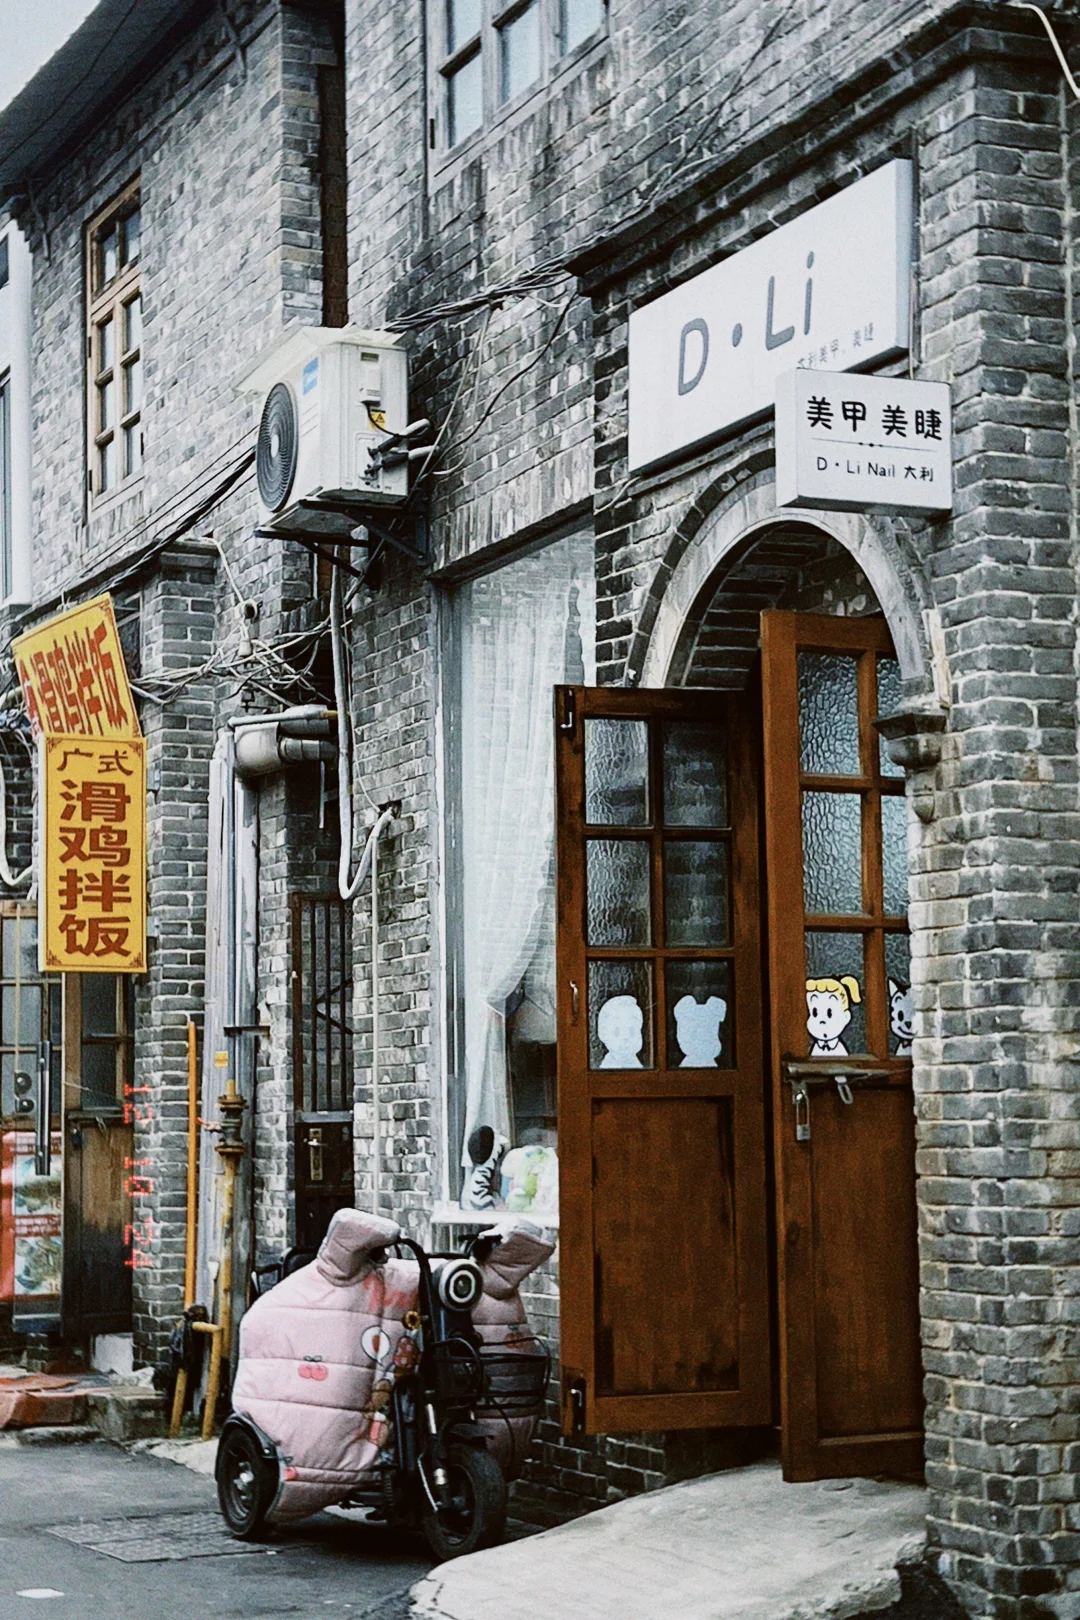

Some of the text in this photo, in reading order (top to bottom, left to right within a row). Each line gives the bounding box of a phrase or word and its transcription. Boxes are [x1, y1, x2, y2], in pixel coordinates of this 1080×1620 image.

[806, 395, 942, 441] 美甲 美睫
[867, 462, 896, 477] Nail
[903, 465, 934, 482] 大利
[56, 748, 134, 776] 广式
[58, 778, 132, 958] 滑鸡拌饭
